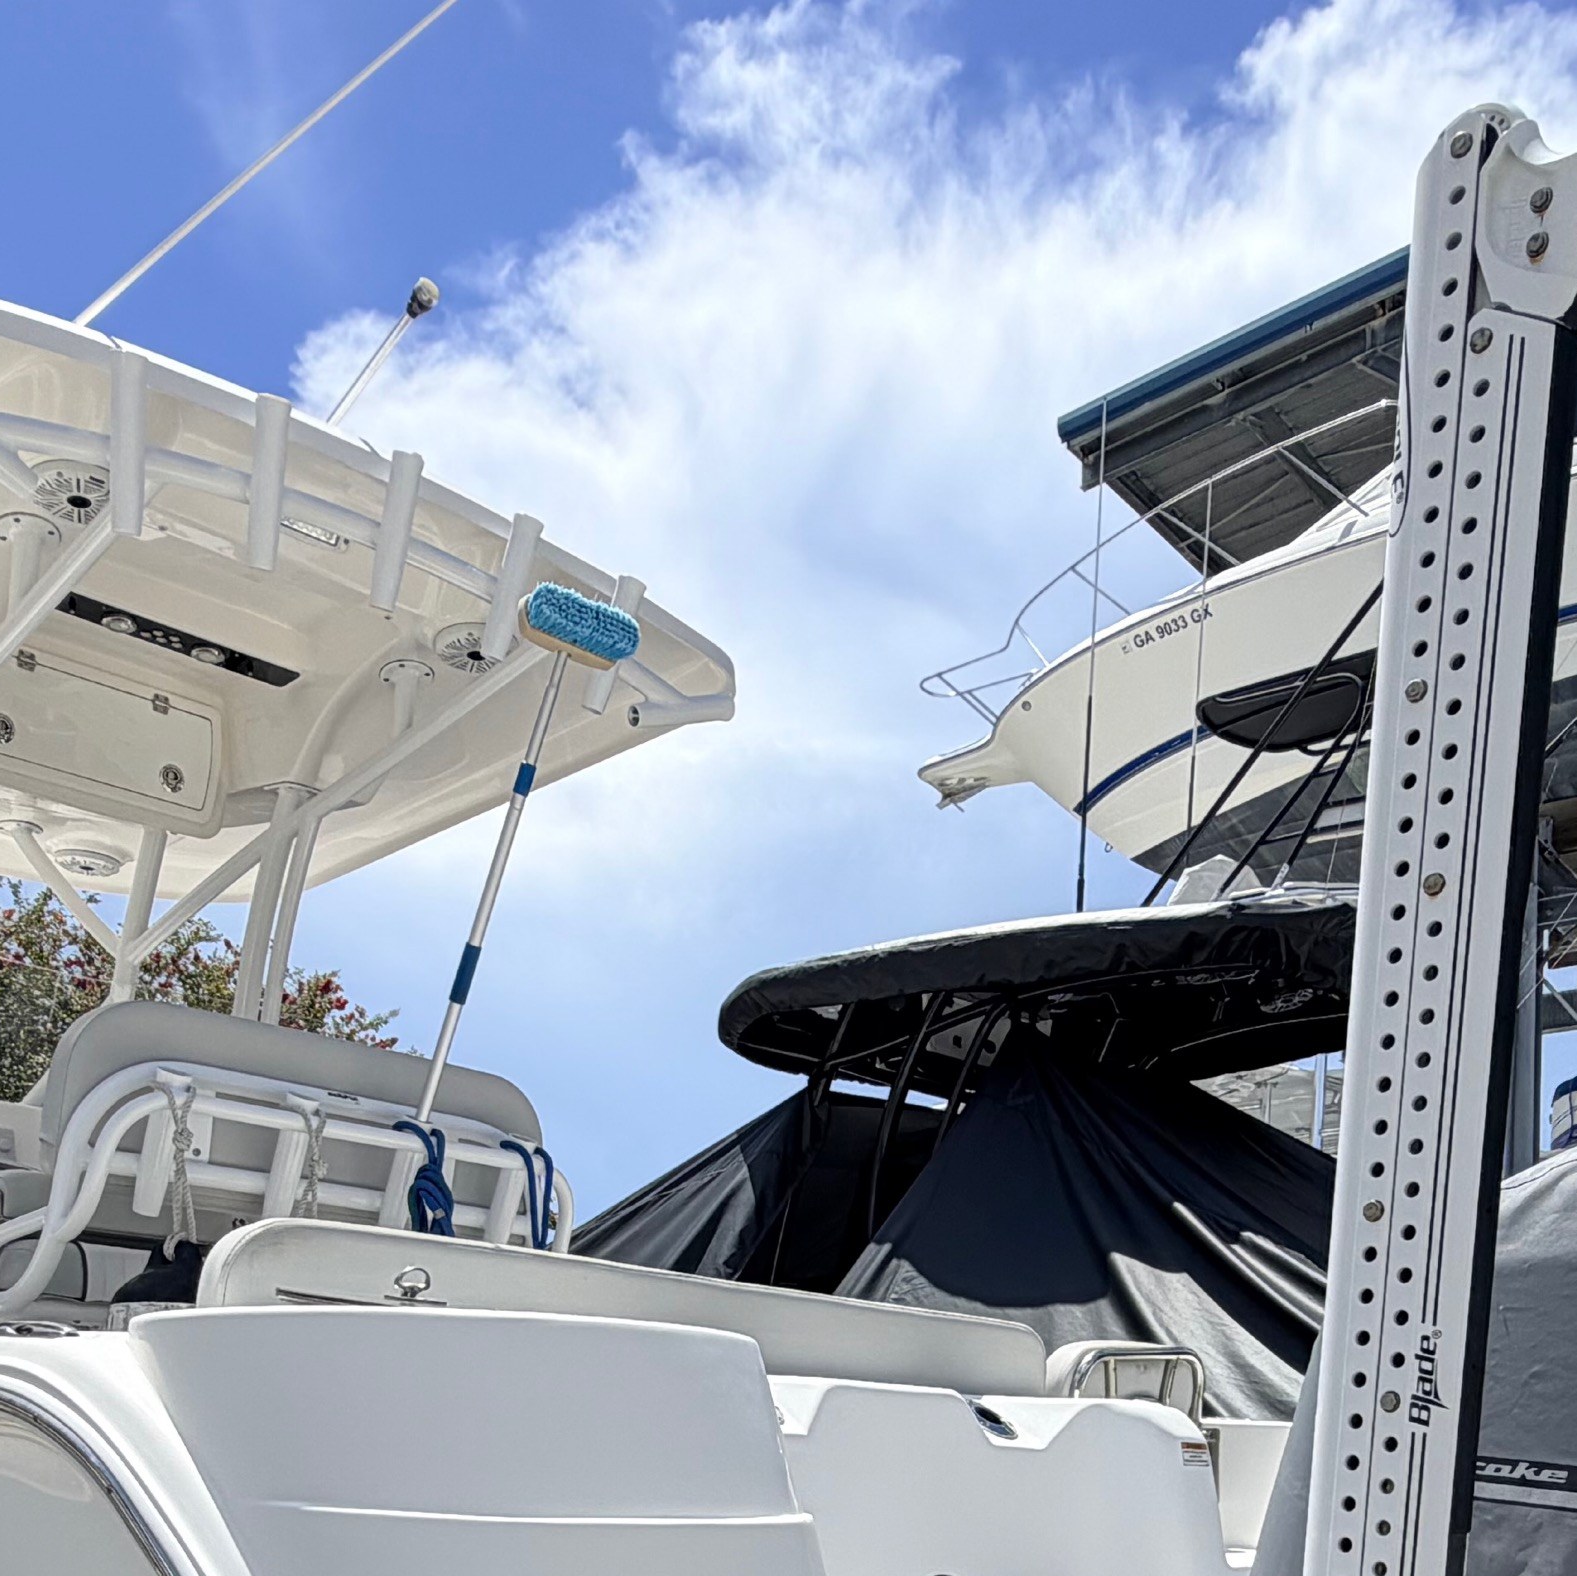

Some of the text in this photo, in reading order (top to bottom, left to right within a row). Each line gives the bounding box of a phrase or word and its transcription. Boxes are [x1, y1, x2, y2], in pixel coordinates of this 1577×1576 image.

[1133, 603, 1213, 648] GA 9033 GX
